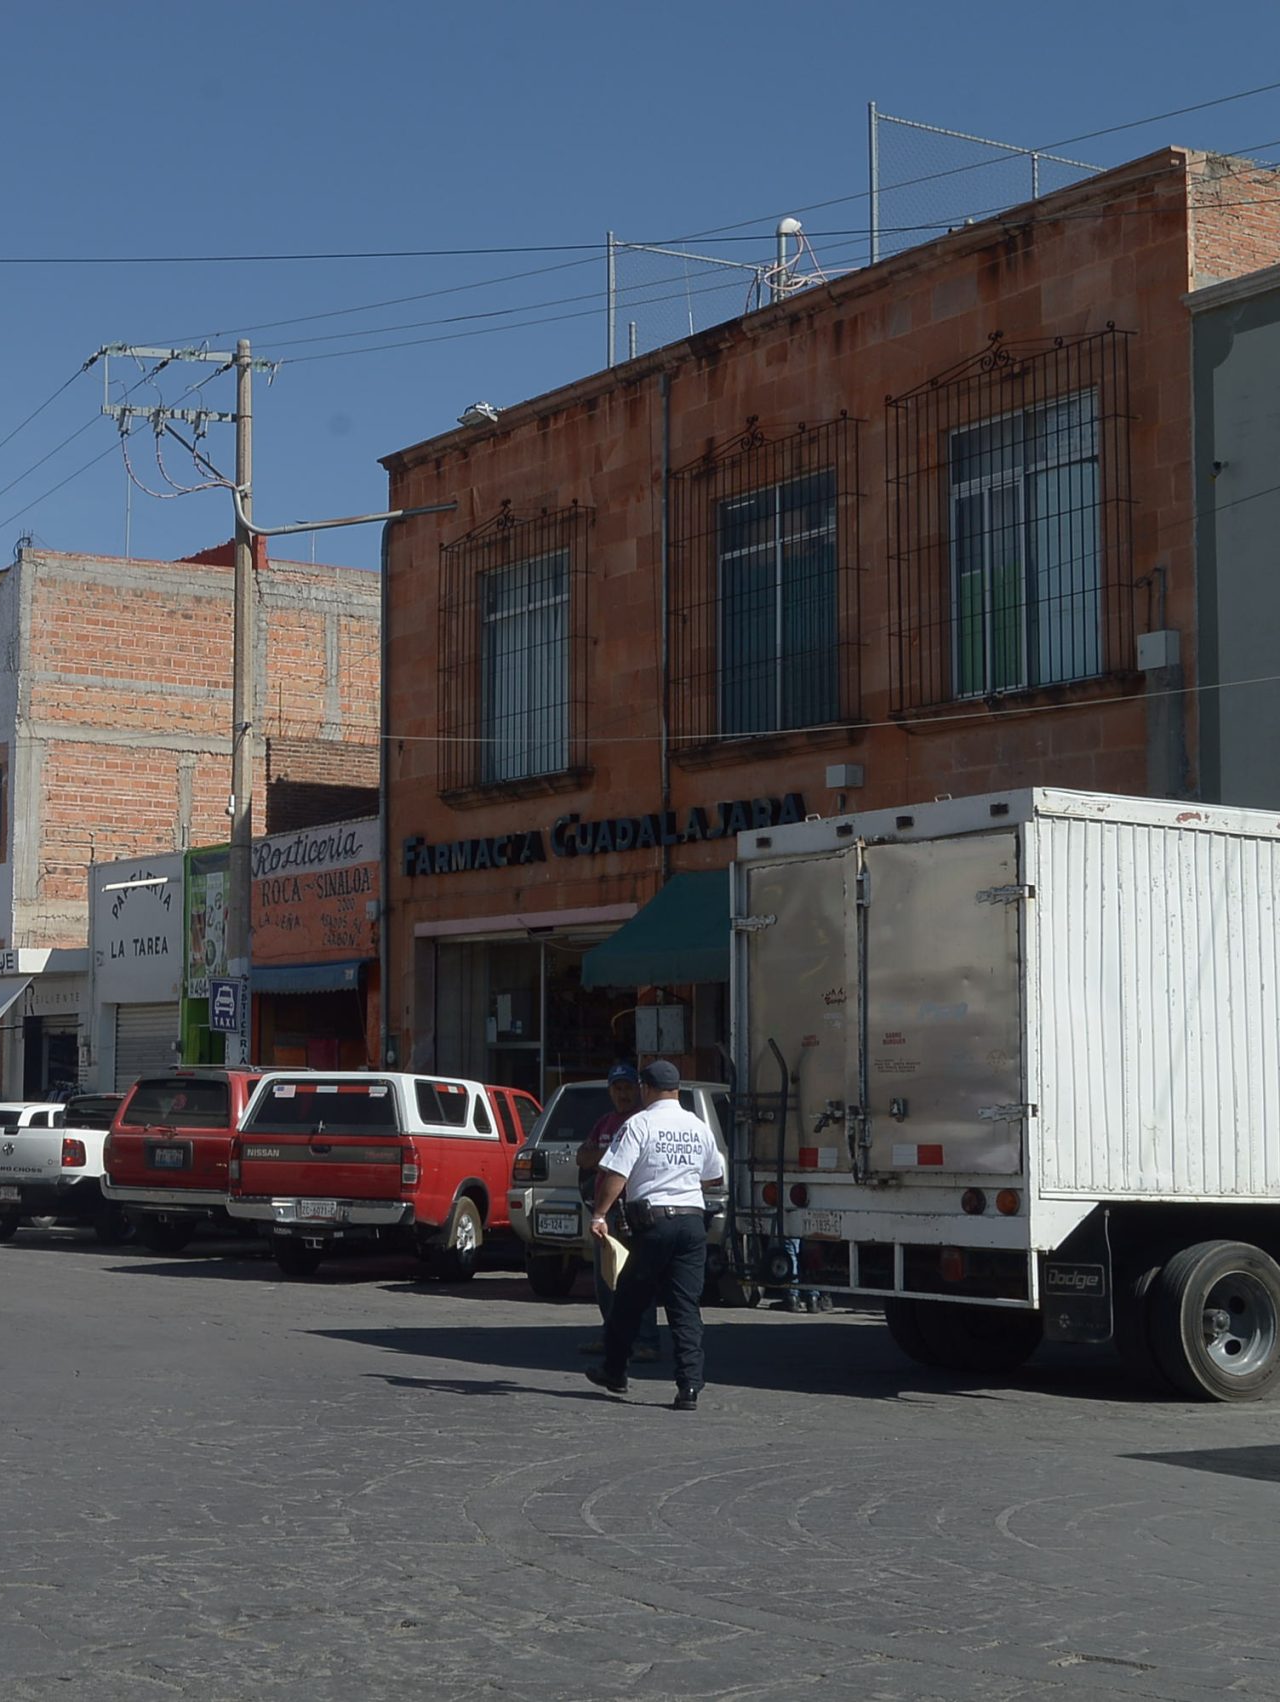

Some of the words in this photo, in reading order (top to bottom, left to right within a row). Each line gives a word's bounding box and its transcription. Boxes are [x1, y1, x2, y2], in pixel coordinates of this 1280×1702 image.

[550, 793, 806, 857] GUADALAJARA
[252, 828, 363, 877] Rosticeria
[111, 869, 172, 919] PAPELERIA
[262, 878, 302, 907] ROCA
[316, 867, 371, 899] SINALOA
[111, 940, 125, 959] LA
[133, 936, 169, 957] TAREA
[214, 1017, 236, 1029] TAXI
[658, 1129, 700, 1143] POLICÍA
[247, 1149, 280, 1157] NISSAN
[655, 1142, 702, 1155] SEGURIDAD
[666, 1154, 695, 1165] VIAL
[1048, 1268, 1099, 1289] Dodge
